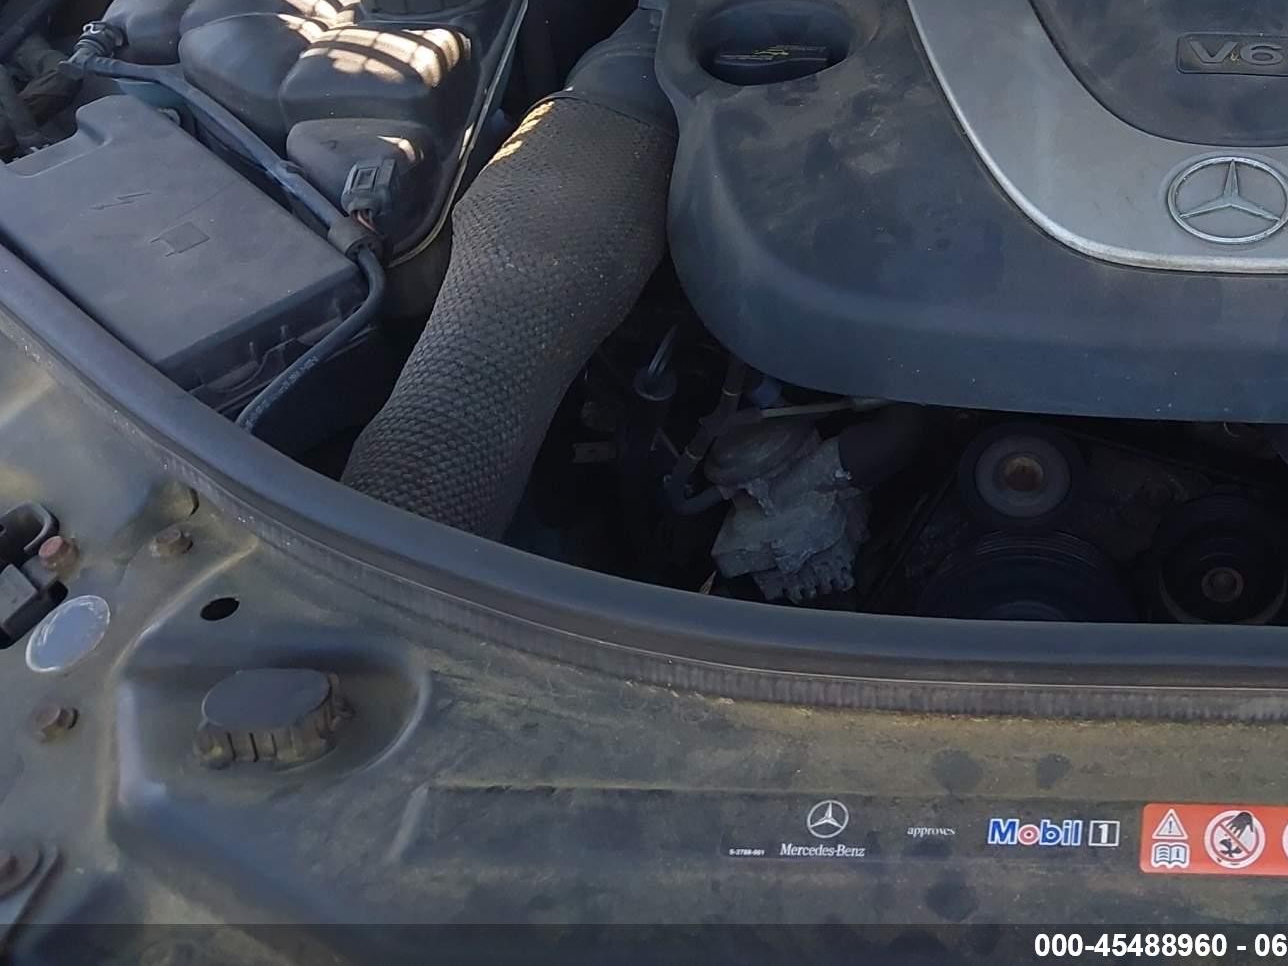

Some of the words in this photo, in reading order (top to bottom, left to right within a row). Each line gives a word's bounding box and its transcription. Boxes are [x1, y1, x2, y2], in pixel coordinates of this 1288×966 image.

[1188, 41, 1285, 66] V6
[907, 826, 956, 838] approves
[987, 818, 1083, 846] Mobil
[780, 843, 866, 858] Mercedes-Benz
